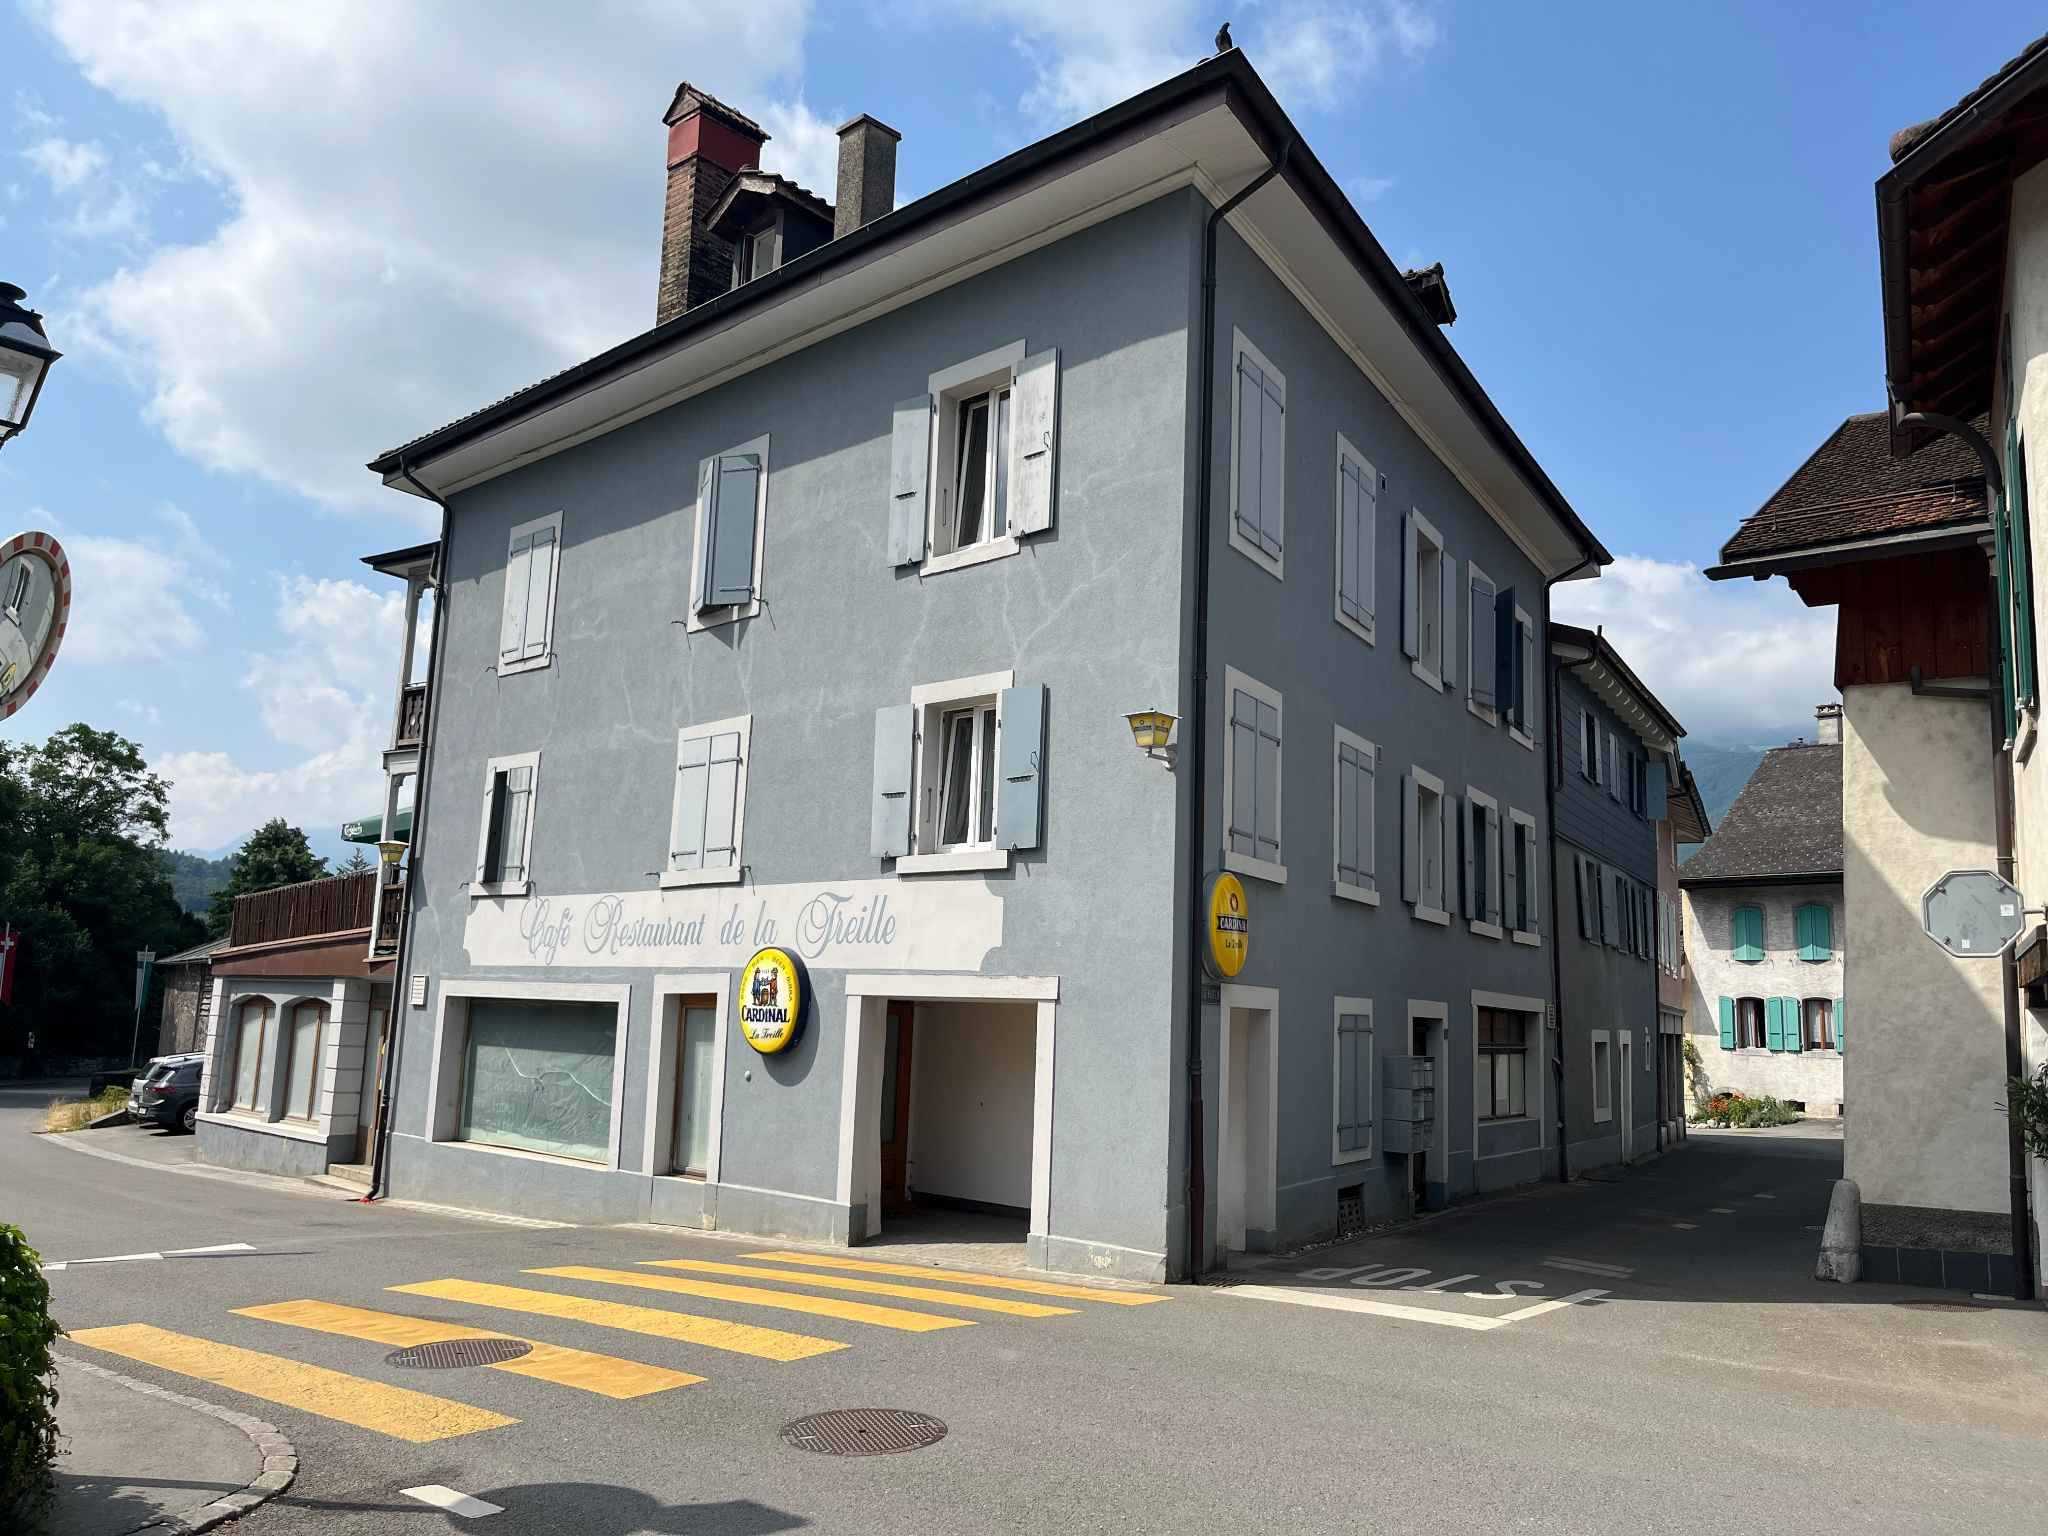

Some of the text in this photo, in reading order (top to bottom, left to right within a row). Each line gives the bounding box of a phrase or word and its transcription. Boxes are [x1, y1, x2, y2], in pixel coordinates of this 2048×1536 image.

[520, 892, 896, 965] Café Restaurant de la Treille
[741, 1004, 790, 1023] CARDINAL
[749, 1027, 784, 1040] La Treille
[1296, 1263, 1545, 1300] STOP
